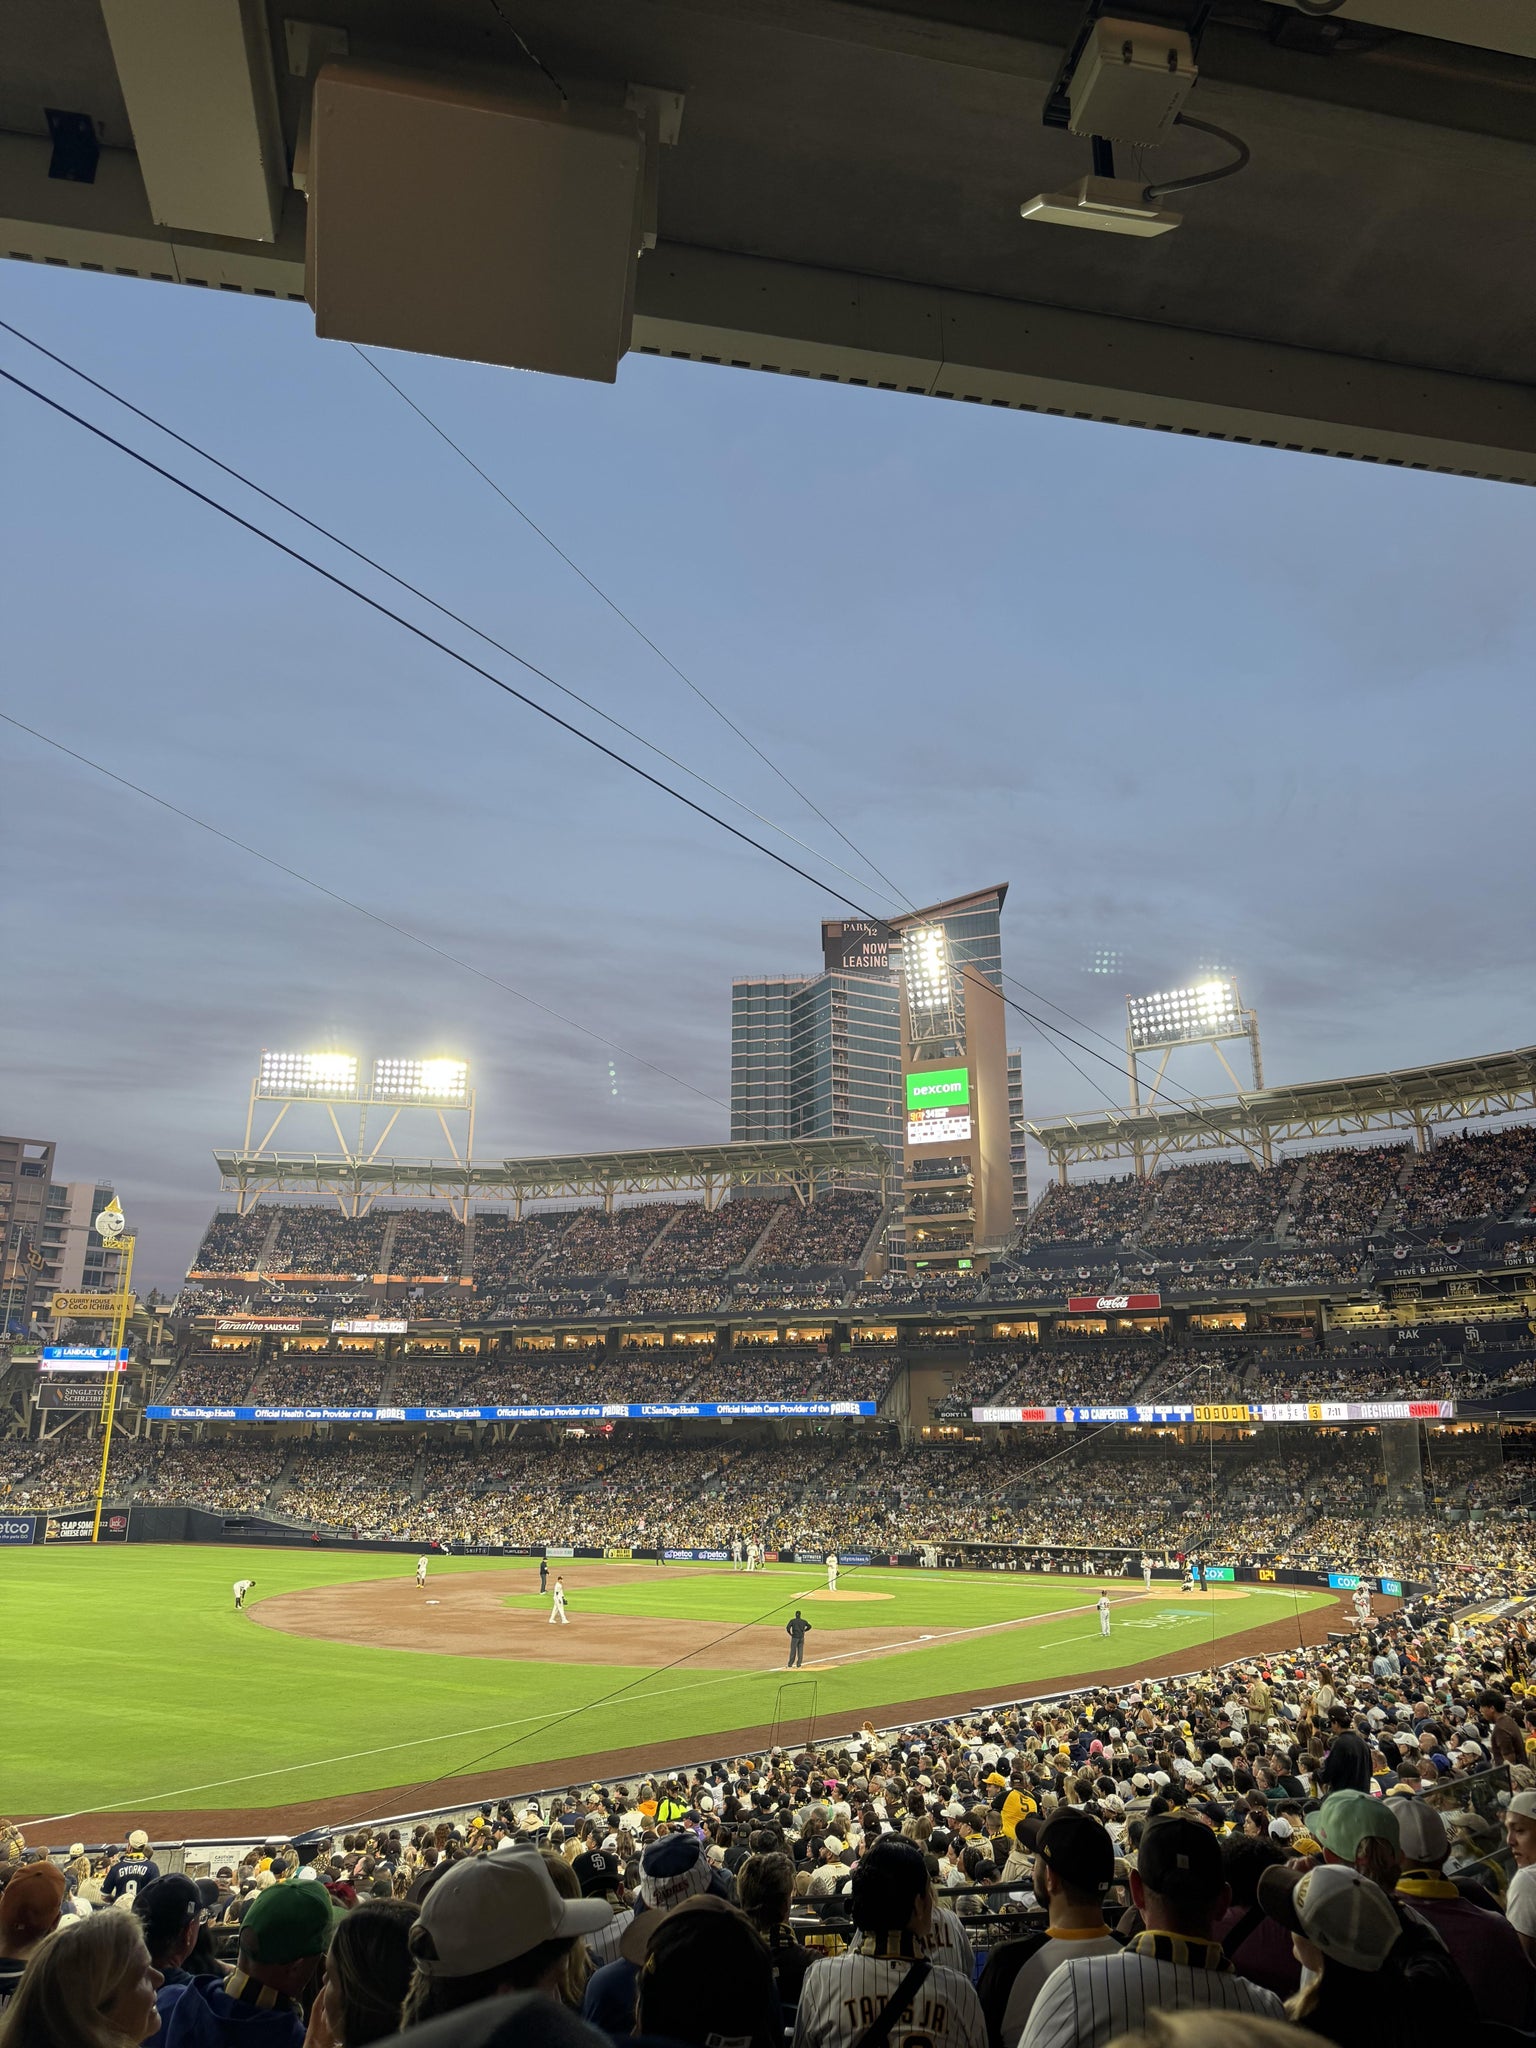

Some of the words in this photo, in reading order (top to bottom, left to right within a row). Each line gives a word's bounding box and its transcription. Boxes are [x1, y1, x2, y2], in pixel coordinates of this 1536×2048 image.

[843, 923, 870, 931] PARK
[867, 928, 878, 936] 12
[862, 943, 887, 955] NOW
[843, 956, 888, 968] LEASING
[1503, 1258, 1522, 1266] TONY
[1525, 1256, 1535, 1264] 19
[1394, 1268, 1416, 1276] STEVE
[1420, 1267, 1426, 1275] 6
[1430, 1264, 1458, 1273] GARVEY
[1449, 1281, 1469, 1291] 97.3
[1096, 1296, 1130, 1309] Coca-Cola
[217, 1319, 263, 1331] Tarantino
[264, 1323, 300, 1331] SAUSAGES
[1398, 1329, 1420, 1339] RAK
[171, 1408, 181, 1417] UC
[182, 1408, 195, 1417] San
[196, 1408, 214, 1418] Diego
[214, 1408, 236, 1417] Health
[254, 1409, 280, 1418] Official
[281, 1409, 304, 1418] Health
[305, 1409, 321, 1418] Care
[322, 1409, 352, 1418] Provider
[353, 1409, 361, 1418] of
[361, 1409, 373, 1418] the
[376, 1408, 406, 1420] PADRES
[425, 1409, 436, 1418] UC
[437, 1409, 448, 1418] San
[448, 1409, 463, 1419] Diego
[463, 1409, 481, 1418] Health
[496, 1408, 519, 1417] Official
[519, 1408, 539, 1417] Health
[539, 1408, 554, 1417] Care
[554, 1407, 581, 1416] Provider
[581, 1407, 589, 1416] of
[589, 1407, 600, 1416] the
[602, 1405, 629, 1417] PADRES
[641, 1405, 651, 1414] UC
[651, 1405, 663, 1414] San
[663, 1405, 680, 1416] Diego
[680, 1405, 699, 1414] Health
[716, 1405, 740, 1414] Official
[741, 1405, 762, 1414] Health
[763, 1404, 779, 1413] Care
[780, 1404, 809, 1413] Provider
[809, 1404, 817, 1413] of
[817, 1404, 829, 1413] the
[830, 1403, 860, 1415] PADRES
[1079, 1409, 1090, 1420] 30
[1203, 1406, 1211, 1420] 0
[1221, 1406, 1229, 1420] 0
[1241, 1406, 1246, 1420] 1
[1312, 1409, 1319, 1419] 3
[1327, 1407, 1341, 1417] 7:11
[1361, 1404, 1410, 1418] NEGIHAMA
[1409, 1402, 1439, 1417] SUSHI
[1022, 1409, 1046, 1421] SUSHI
[60, 1521, 77, 1530] SLAP
[77, 1520, 95, 1530] SOME
[60, 1529, 79, 1537] CHEESE
[79, 1529, 88, 1537] ON
[672, 1550, 693, 1558] petco
[706, 1550, 728, 1558] petco
[1259, 1569, 1276, 1581] 024
[1337, 1577, 1357, 1588] COX
[1386, 1582, 1399, 1592] COX
[1020, 1794, 1029, 1813] 5
[591, 1853, 606, 1871] SD
[118, 1864, 148, 1878] GYORKO
[844, 1995, 914, 2028] TATS
